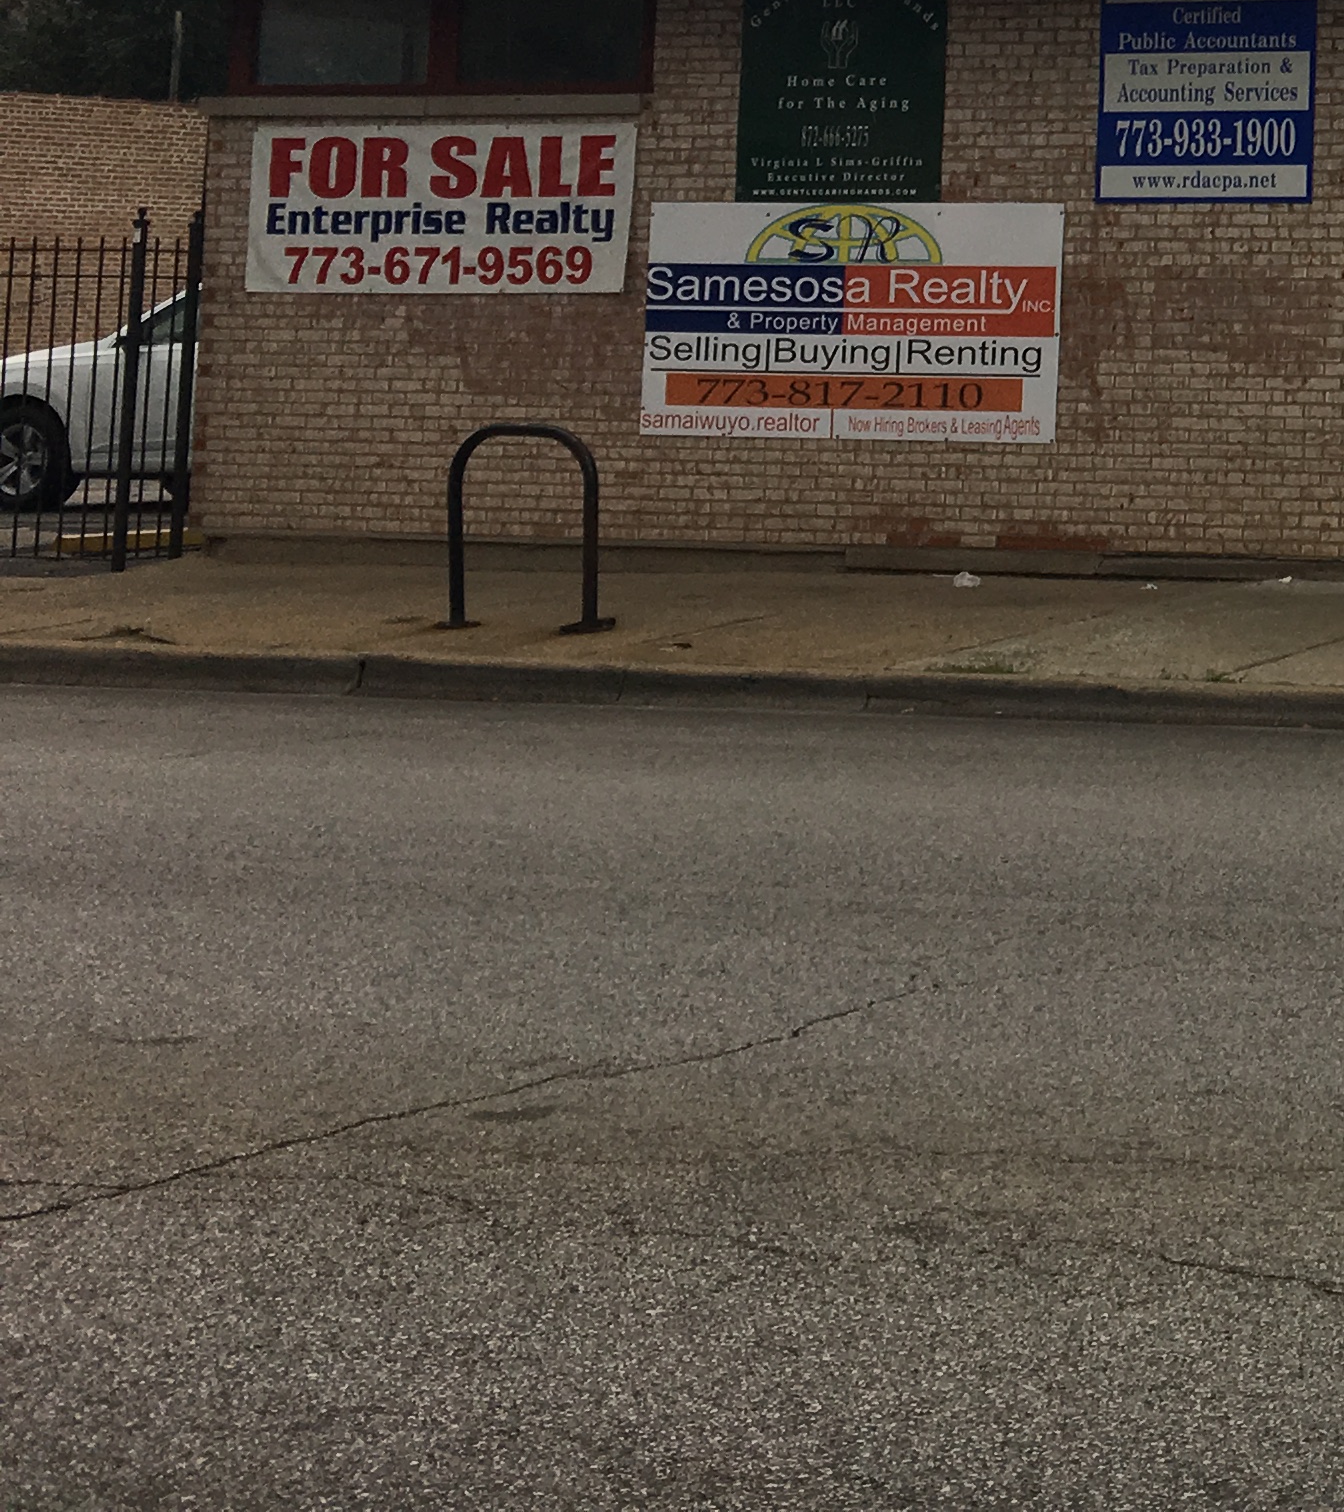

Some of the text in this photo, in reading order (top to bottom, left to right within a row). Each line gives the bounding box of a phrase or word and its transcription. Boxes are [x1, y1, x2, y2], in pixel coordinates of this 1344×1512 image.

[1172, 7, 1241, 25] Certified
[1118, 32, 1297, 50] Public Accountants
[1127, 57, 1293, 78] Tax Preparation &
[786, 74, 887, 87] Home Care
[777, 97, 910, 112] for The Aging
[1117, 81, 1298, 106] Accounting Services
[1115, 118, 1296, 158] 773-933-1900
[268, 135, 617, 199] FOR SALE
[751, 156, 923, 170] Virginia L Sims-Griffin
[767, 172, 905, 182] Executive Director
[1132, 171, 1277, 192] www.rdacpa.net
[266, 202, 615, 242] Enterprise Realty
[284, 245, 593, 285] 773-671-9569
[646, 266, 1055, 314] Samesosa Realty INC.
[726, 313, 987, 335] & Property Management
[696, 377, 984, 409] 773-817-2110
[641, 411, 821, 434] samaiwuyo.realtor
[848, 415, 1041, 439] Now Hiring Brokers & Leasing Agents
